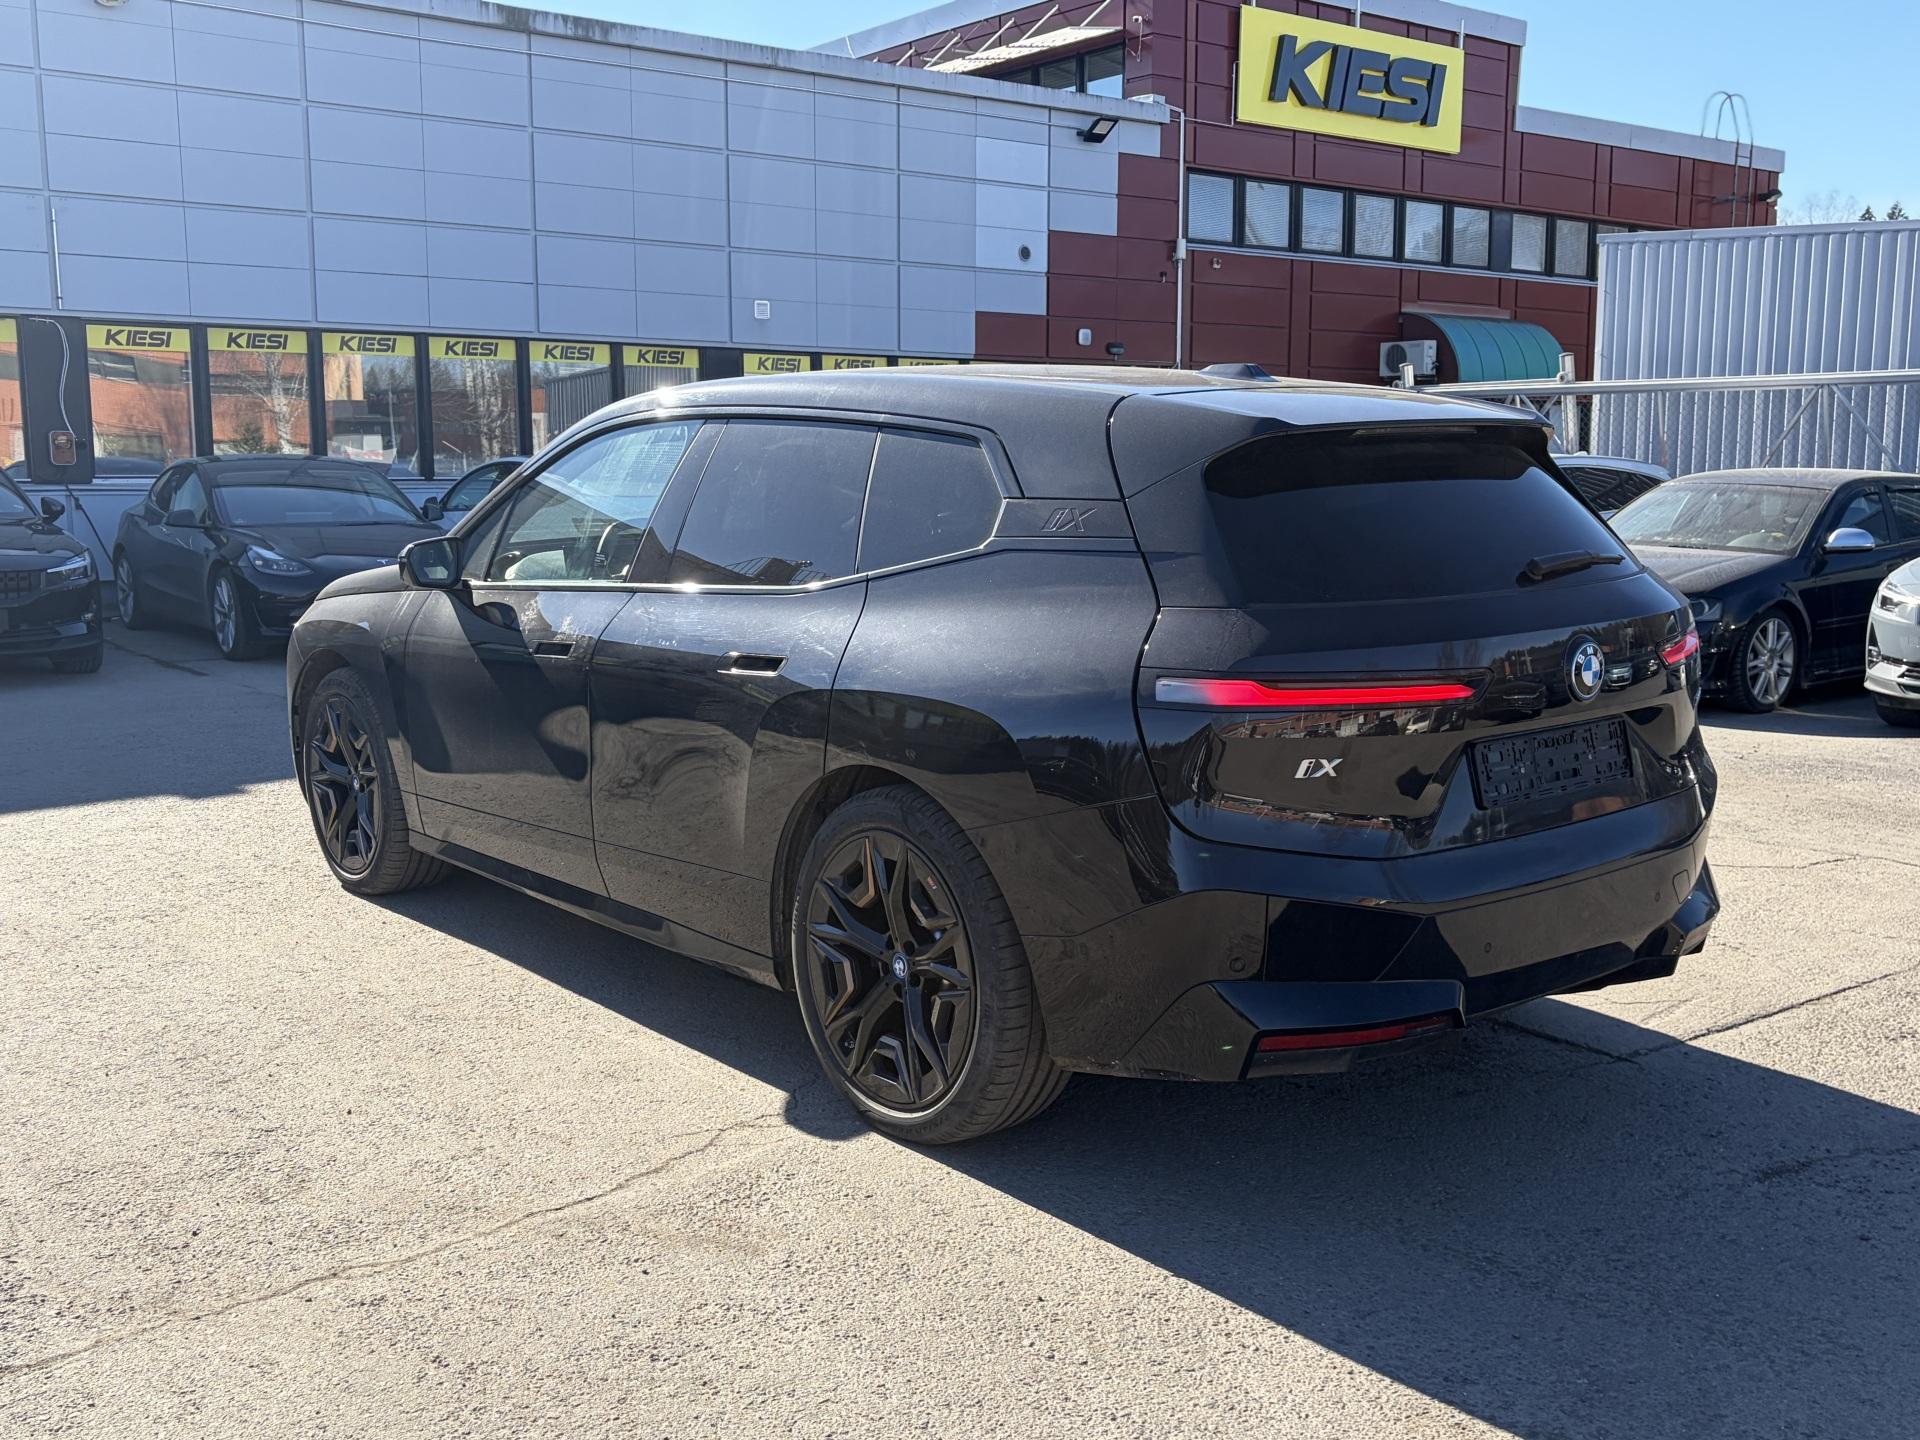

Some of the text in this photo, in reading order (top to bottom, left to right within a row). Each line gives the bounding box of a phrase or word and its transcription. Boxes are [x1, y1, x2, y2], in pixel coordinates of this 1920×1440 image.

[1268, 34, 1447, 127] KIESI
[105, 328, 172, 348] KIESI
[226, 331, 289, 350] KIESI
[339, 335, 397, 353] KIESI
[444, 340, 499, 357] KIESI
[544, 344, 595, 362] KIESI
[637, 348, 685, 365] KIESI
[757, 356, 801, 372] KIESI
